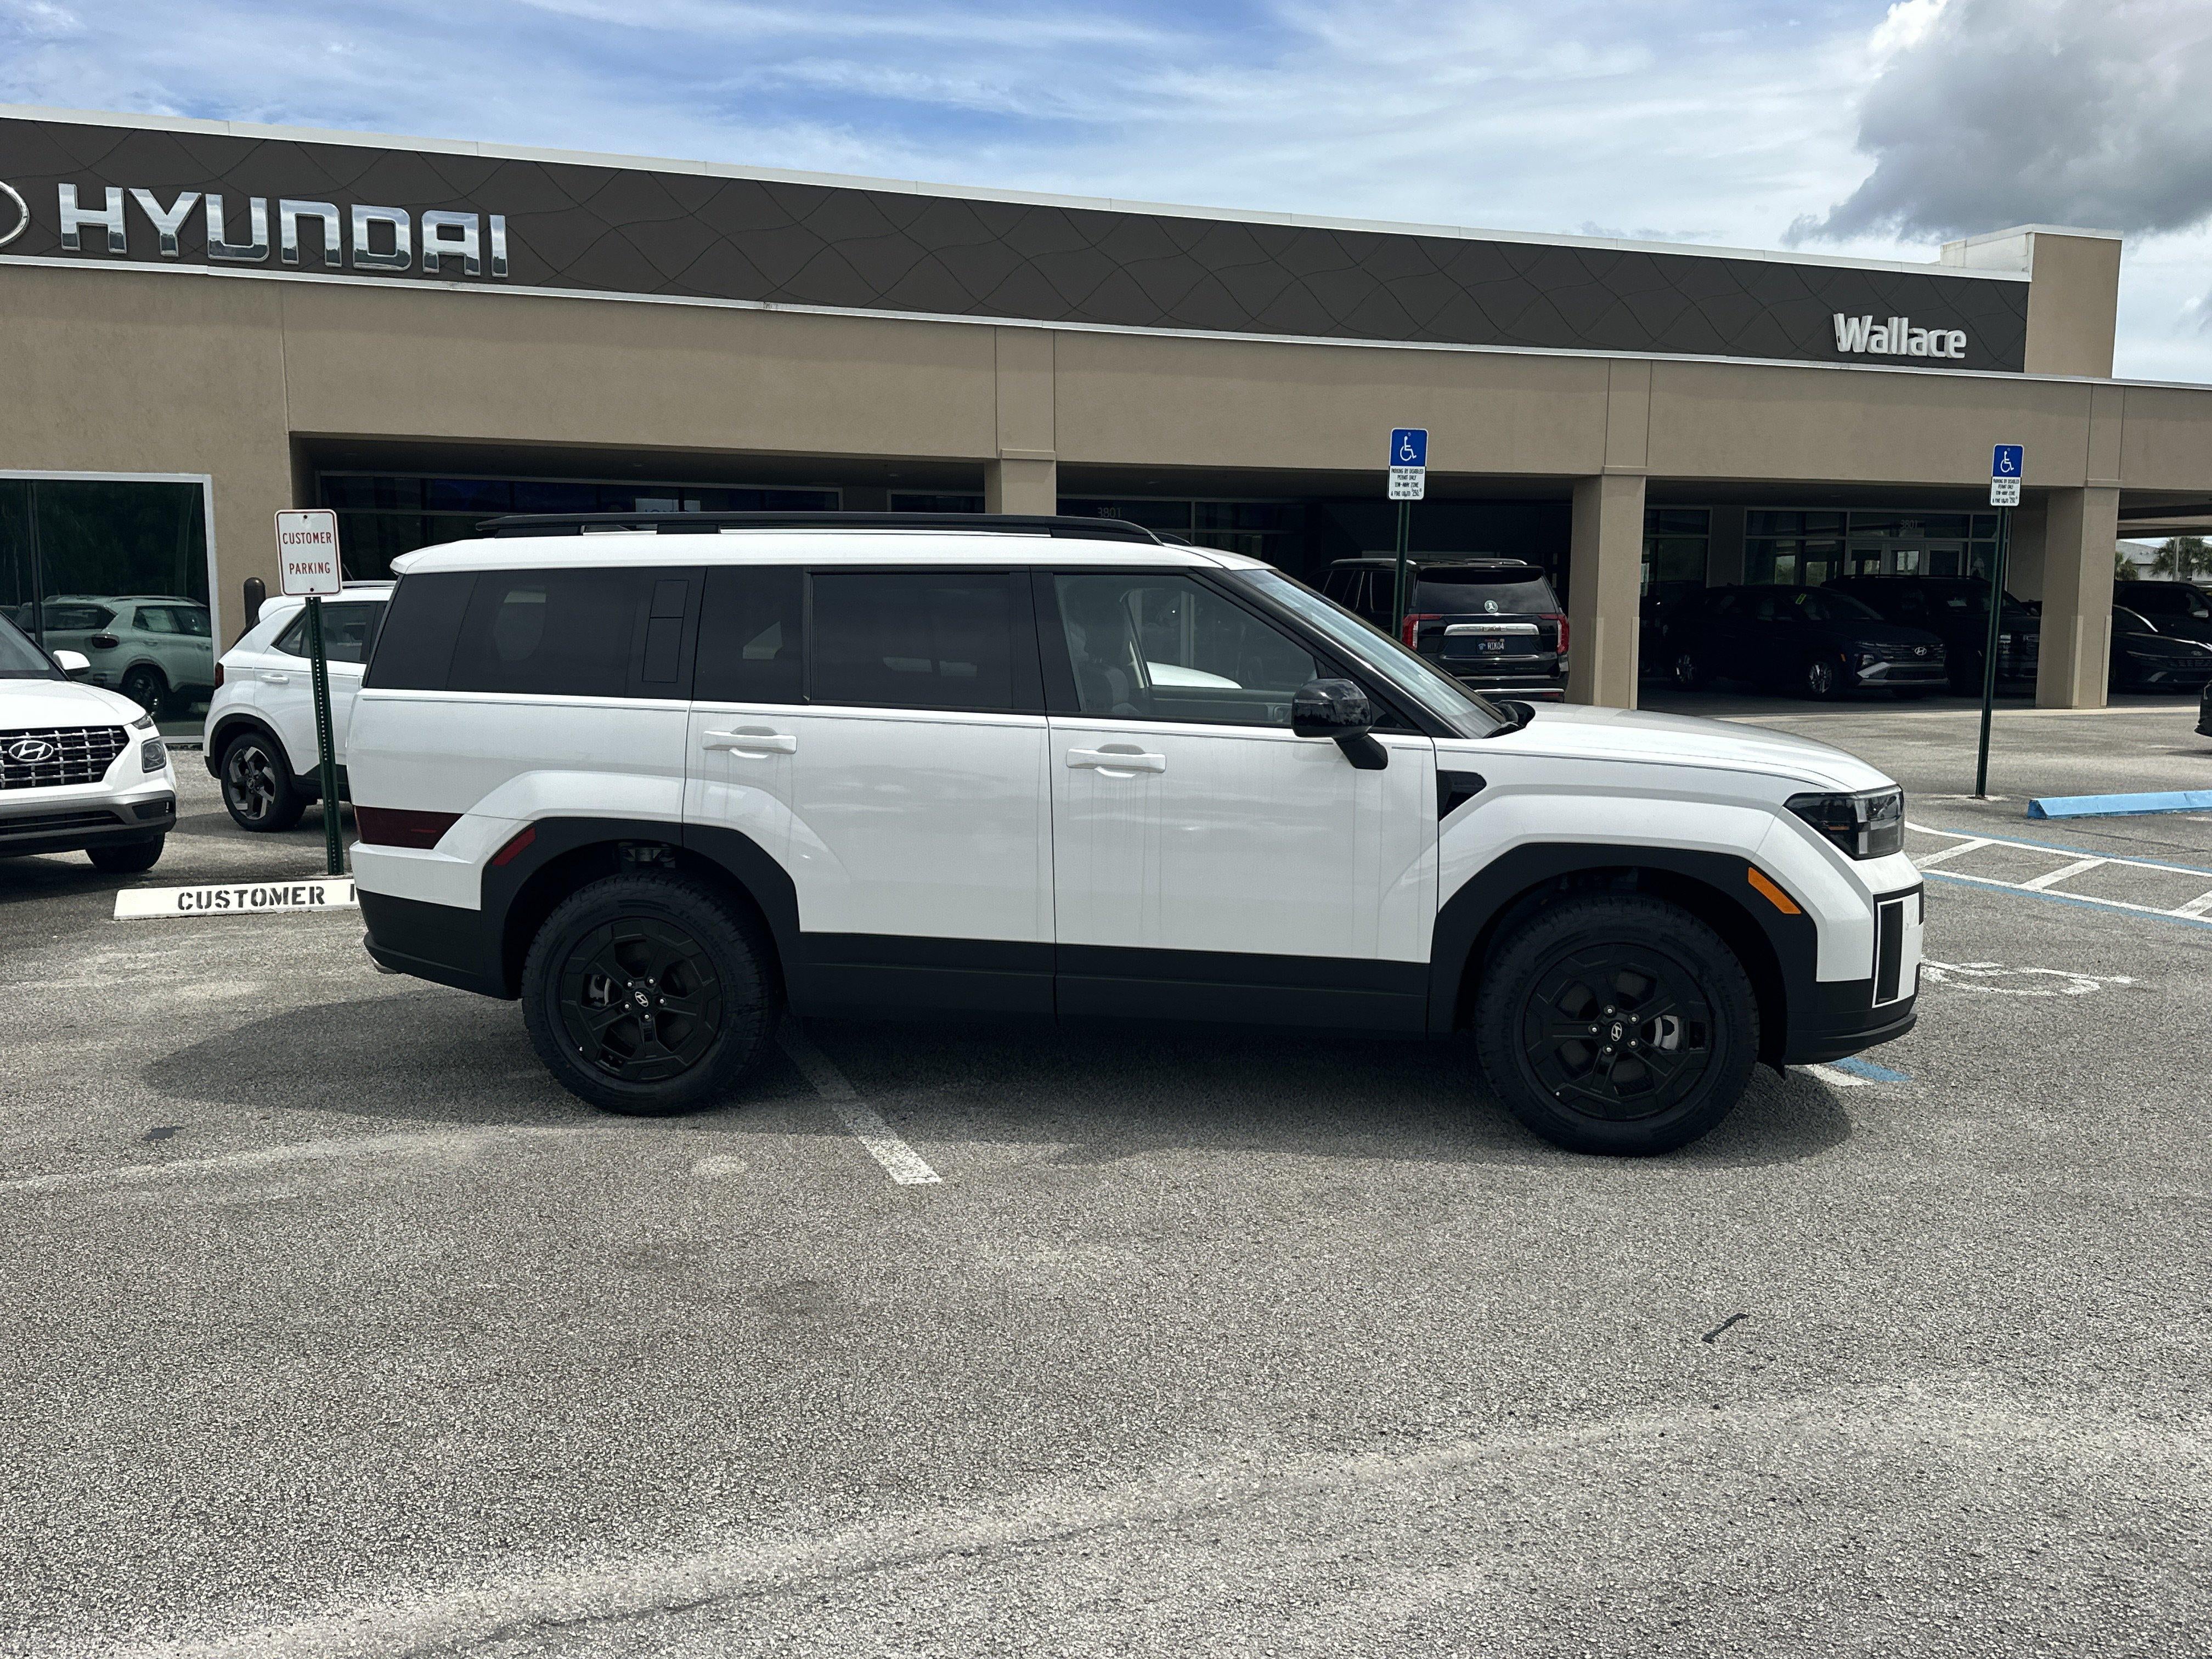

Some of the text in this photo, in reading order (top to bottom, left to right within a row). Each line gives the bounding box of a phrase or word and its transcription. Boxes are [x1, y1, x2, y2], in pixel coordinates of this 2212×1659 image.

[58, 183, 509, 278] HYUNDAI
[1833, 313, 1967, 358] Wallace
[283, 532, 332, 544] CUSTOMER
[289, 562, 330, 574] PARKING
[178, 886, 325, 911] CUSTOMER
